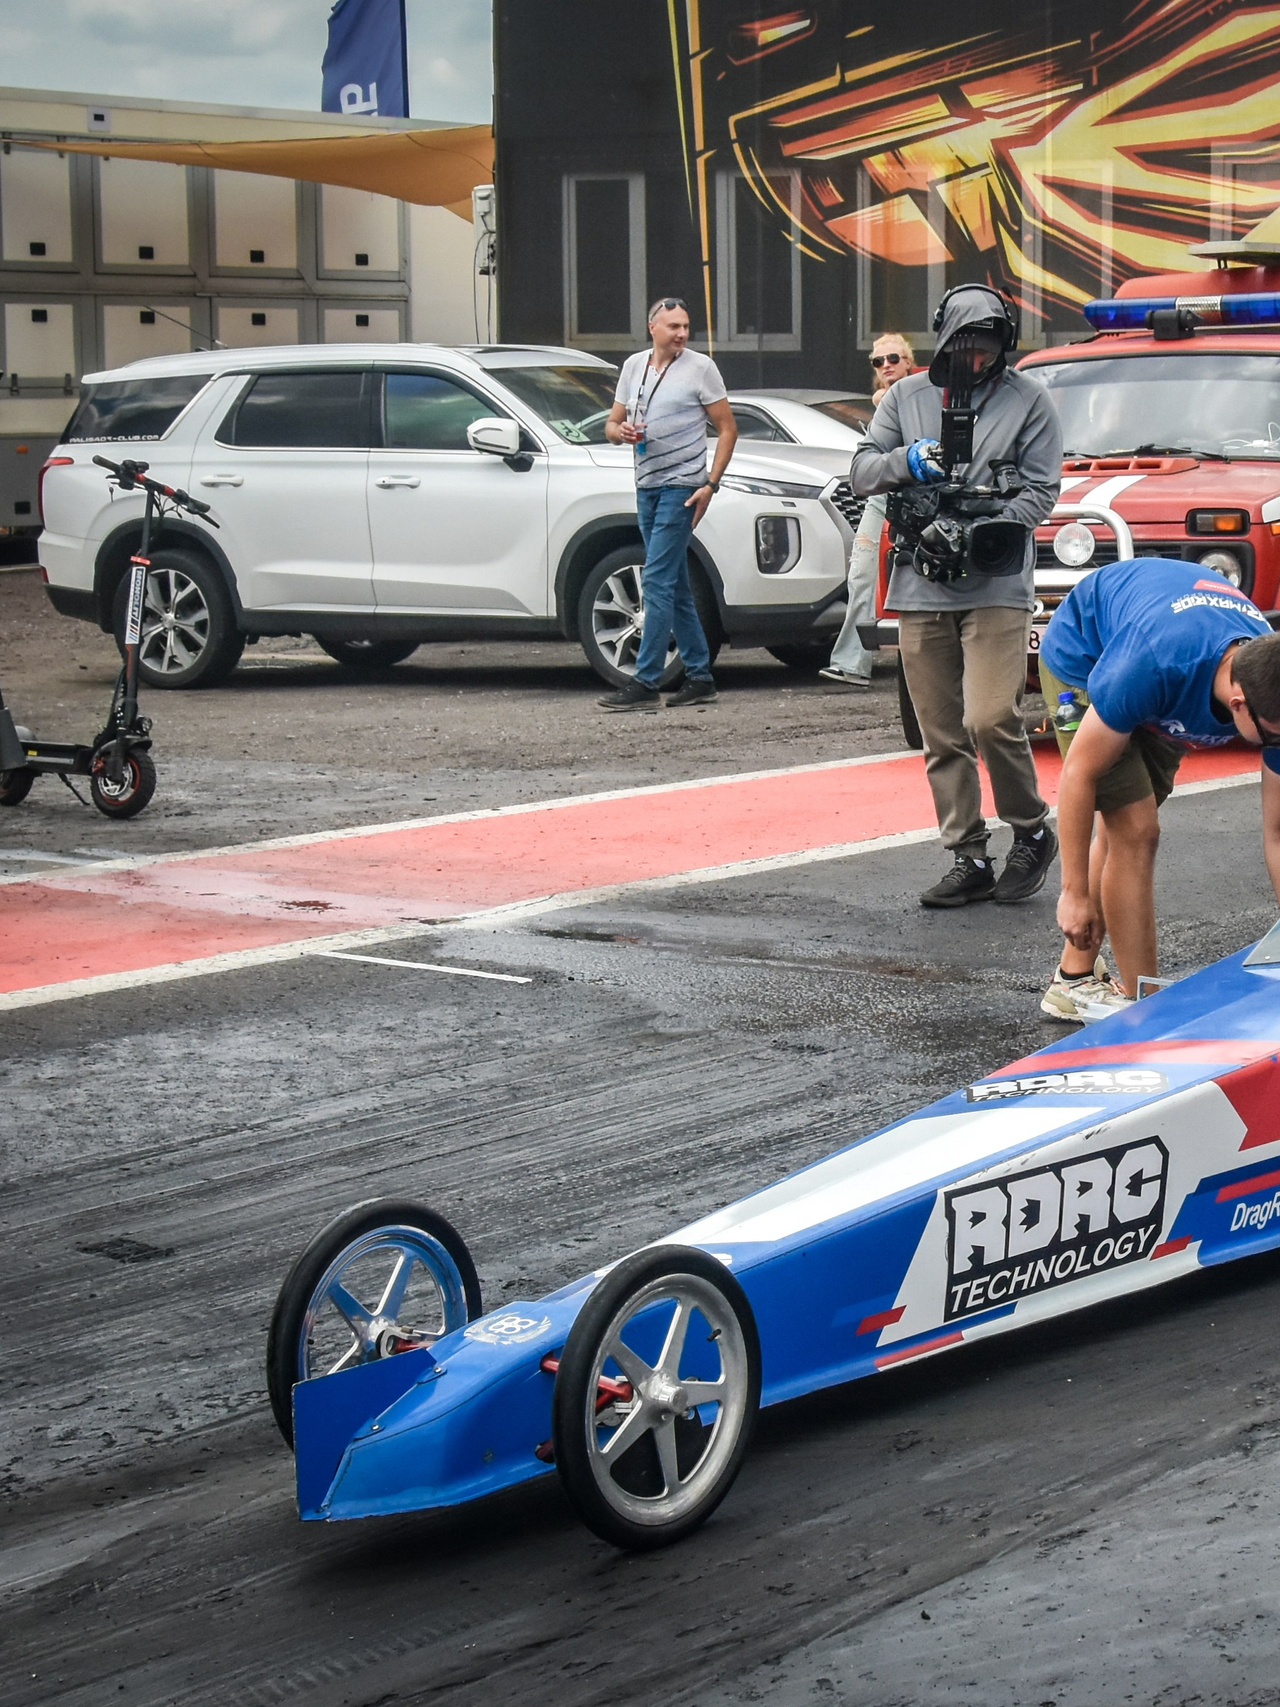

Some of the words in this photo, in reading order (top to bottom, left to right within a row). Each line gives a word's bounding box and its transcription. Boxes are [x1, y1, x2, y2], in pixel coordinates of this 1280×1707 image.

[132, 570, 142, 618] MONOLIT
[969, 1070, 1162, 1097] RDRC
[973, 1085, 1163, 1102] TECHNOLOGY
[952, 1142, 1162, 1275] RDRC
[951, 1224, 1157, 1313] TECHNOLOGY
